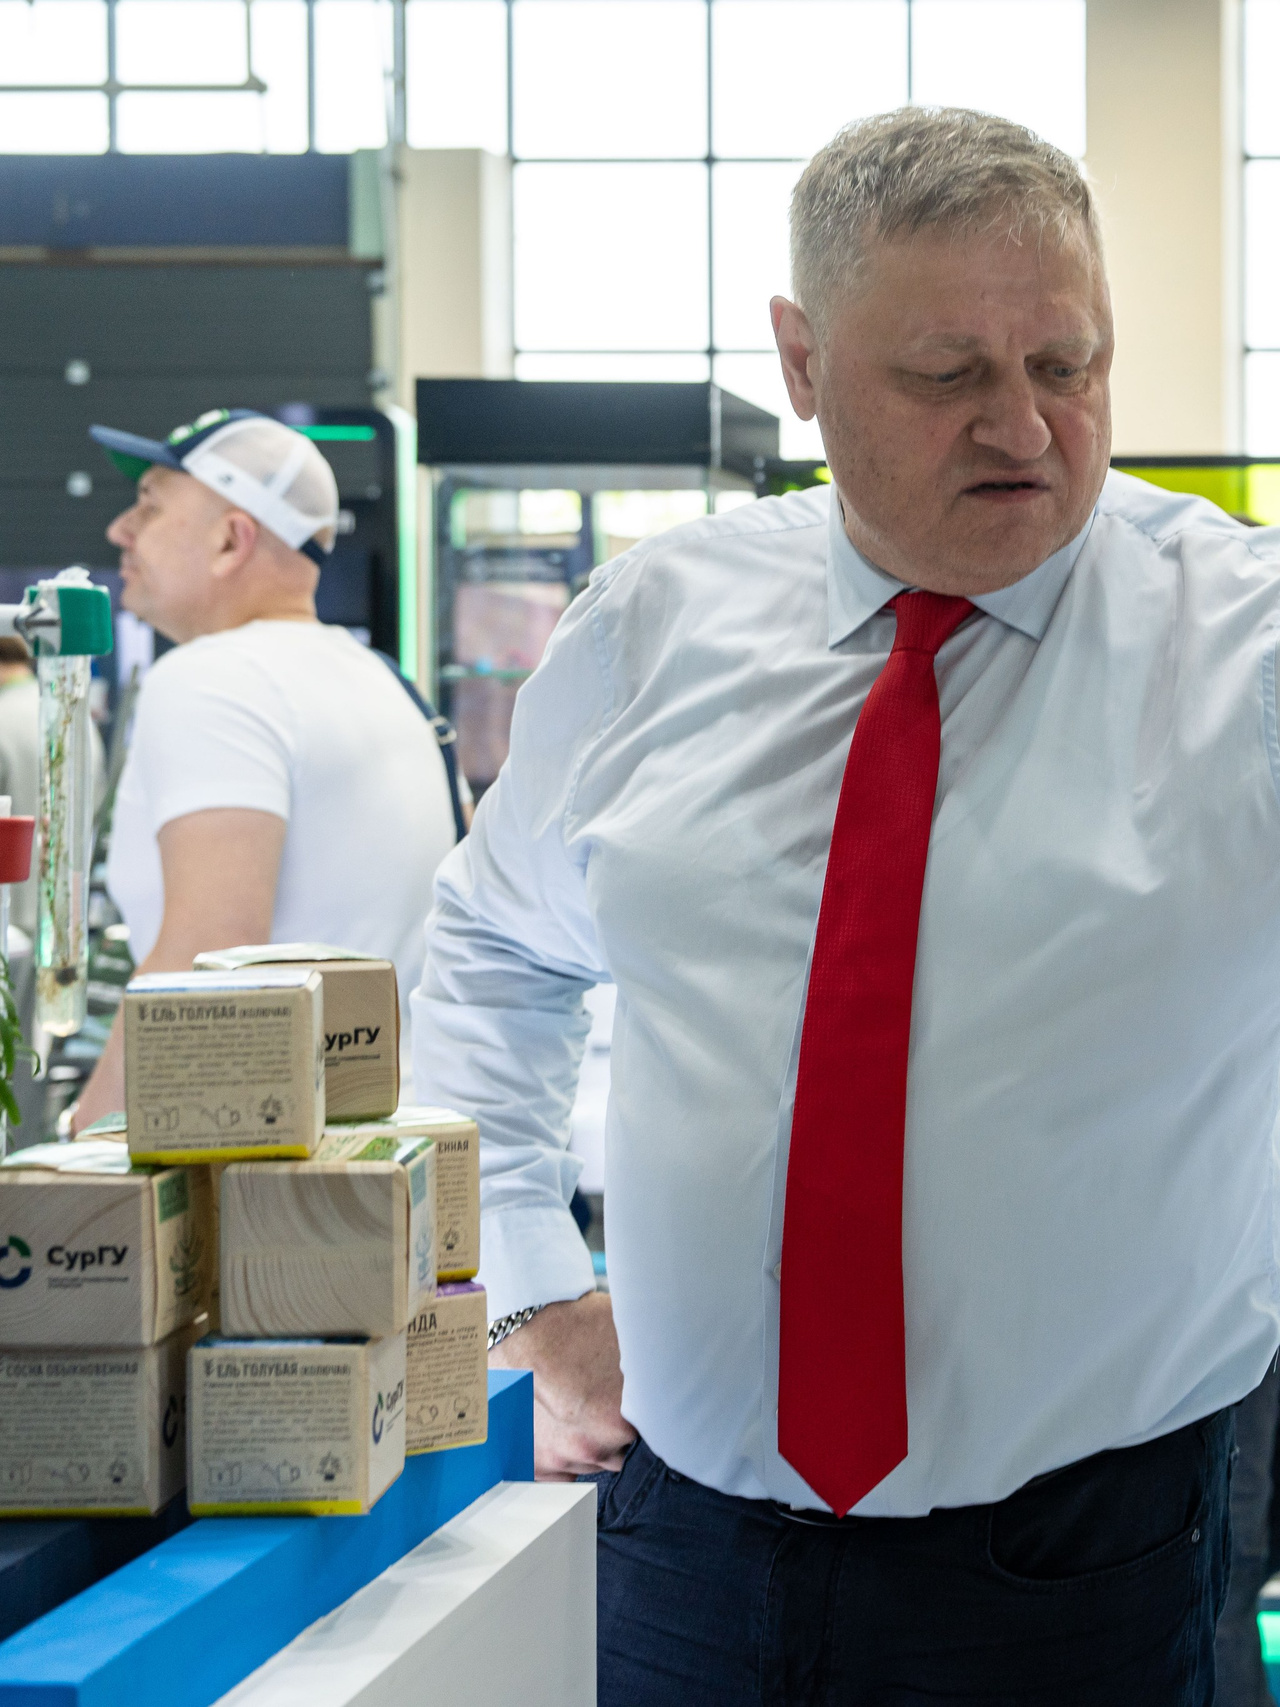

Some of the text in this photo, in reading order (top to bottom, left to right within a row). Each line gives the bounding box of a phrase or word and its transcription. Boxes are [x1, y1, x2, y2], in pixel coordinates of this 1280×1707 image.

[152, 1005, 292, 1022] ЕЛЬ ГОЛУБАЯ (КОЛЮЧАЯ)
[325, 1027, 381, 1051] урГУ
[438, 1140, 469, 1154] ЕННАЯ
[47, 1245, 129, 1271] СурГУ
[407, 1312, 438, 1334] НДА
[6, 1361, 139, 1377] СОСНА ОБЫКНОВЕННАЯ
[217, 1362, 351, 1378] ЕЛЬ ГОЛУБАЯ (КОЛЮЧАЯ)
